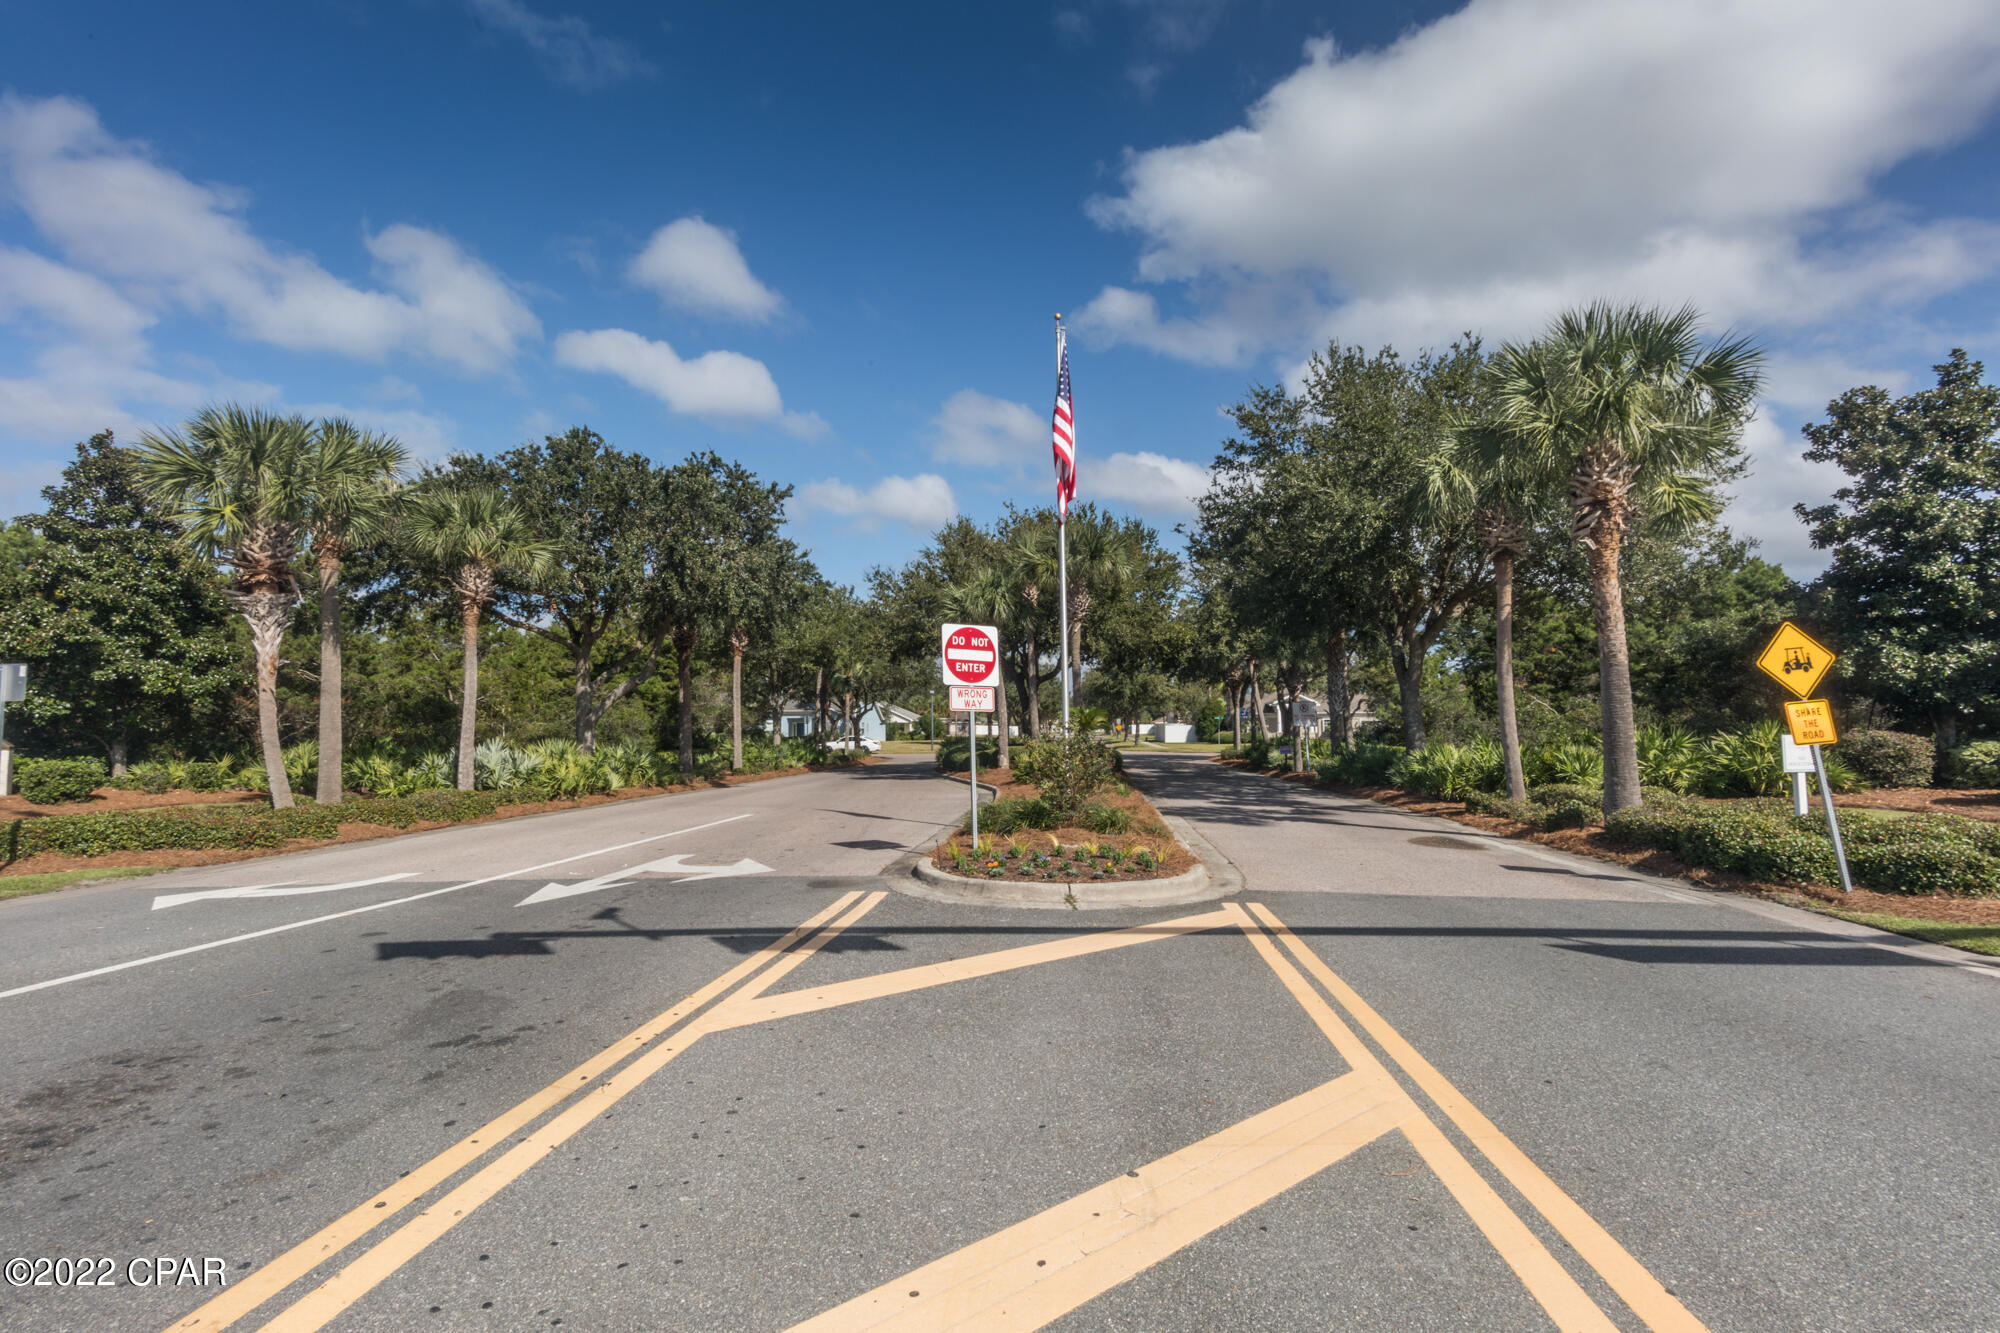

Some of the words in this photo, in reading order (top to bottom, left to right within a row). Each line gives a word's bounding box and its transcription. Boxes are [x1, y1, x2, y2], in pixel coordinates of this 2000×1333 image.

[952, 635, 965, 645] DO
[971, 637, 989, 647] NOT
[955, 662, 986, 673] ENTER
[957, 689, 988, 699] WRONG
[964, 699, 983, 709] WAY
[1795, 707, 1822, 718] SHARE
[1803, 719, 1819, 728] THE
[1802, 730, 1825, 739] ROAD
